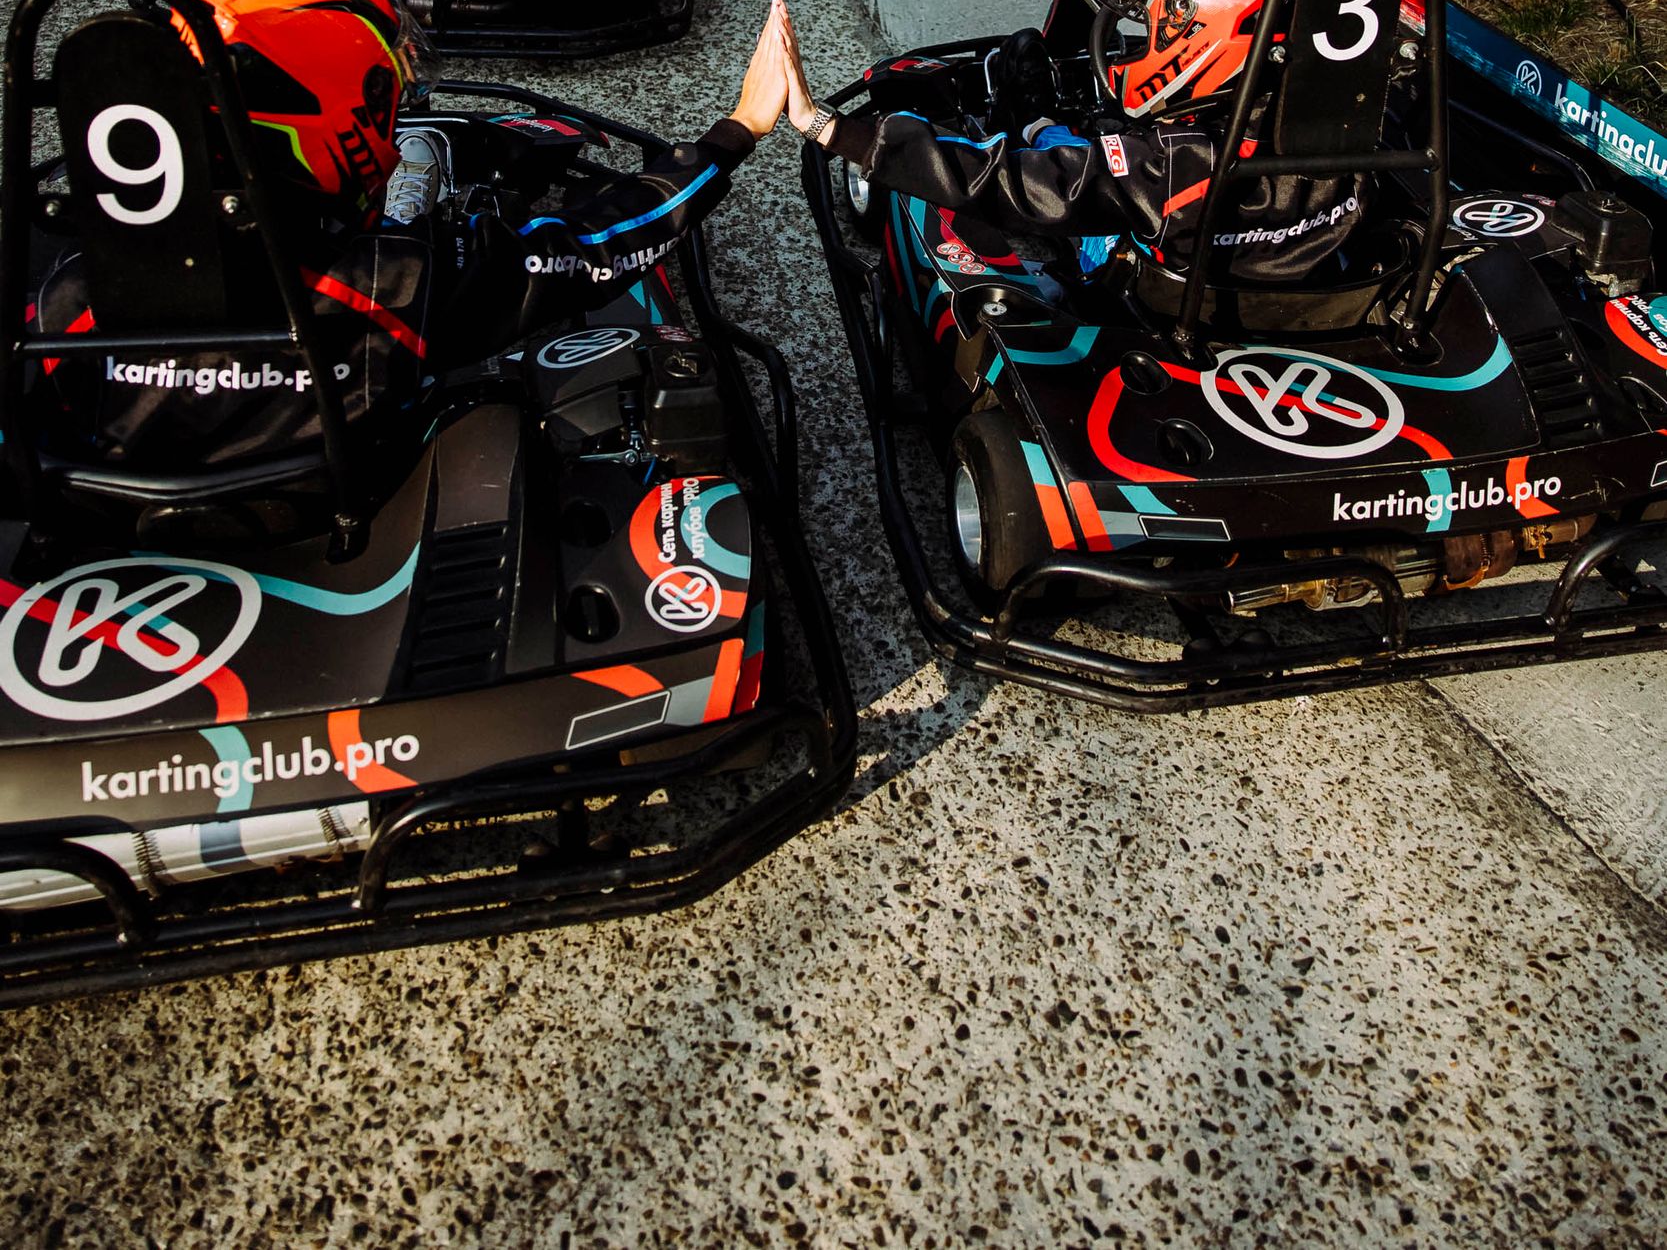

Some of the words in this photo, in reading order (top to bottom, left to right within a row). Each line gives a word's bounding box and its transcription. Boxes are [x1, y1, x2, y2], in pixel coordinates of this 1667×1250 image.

[87, 103, 184, 225] 9
[1105, 137, 1123, 171] RLG
[1333, 476, 1562, 522] kartingclub.pro
[657, 528, 677, 564] Сеть
[81, 733, 421, 802] kartingclub.pro
